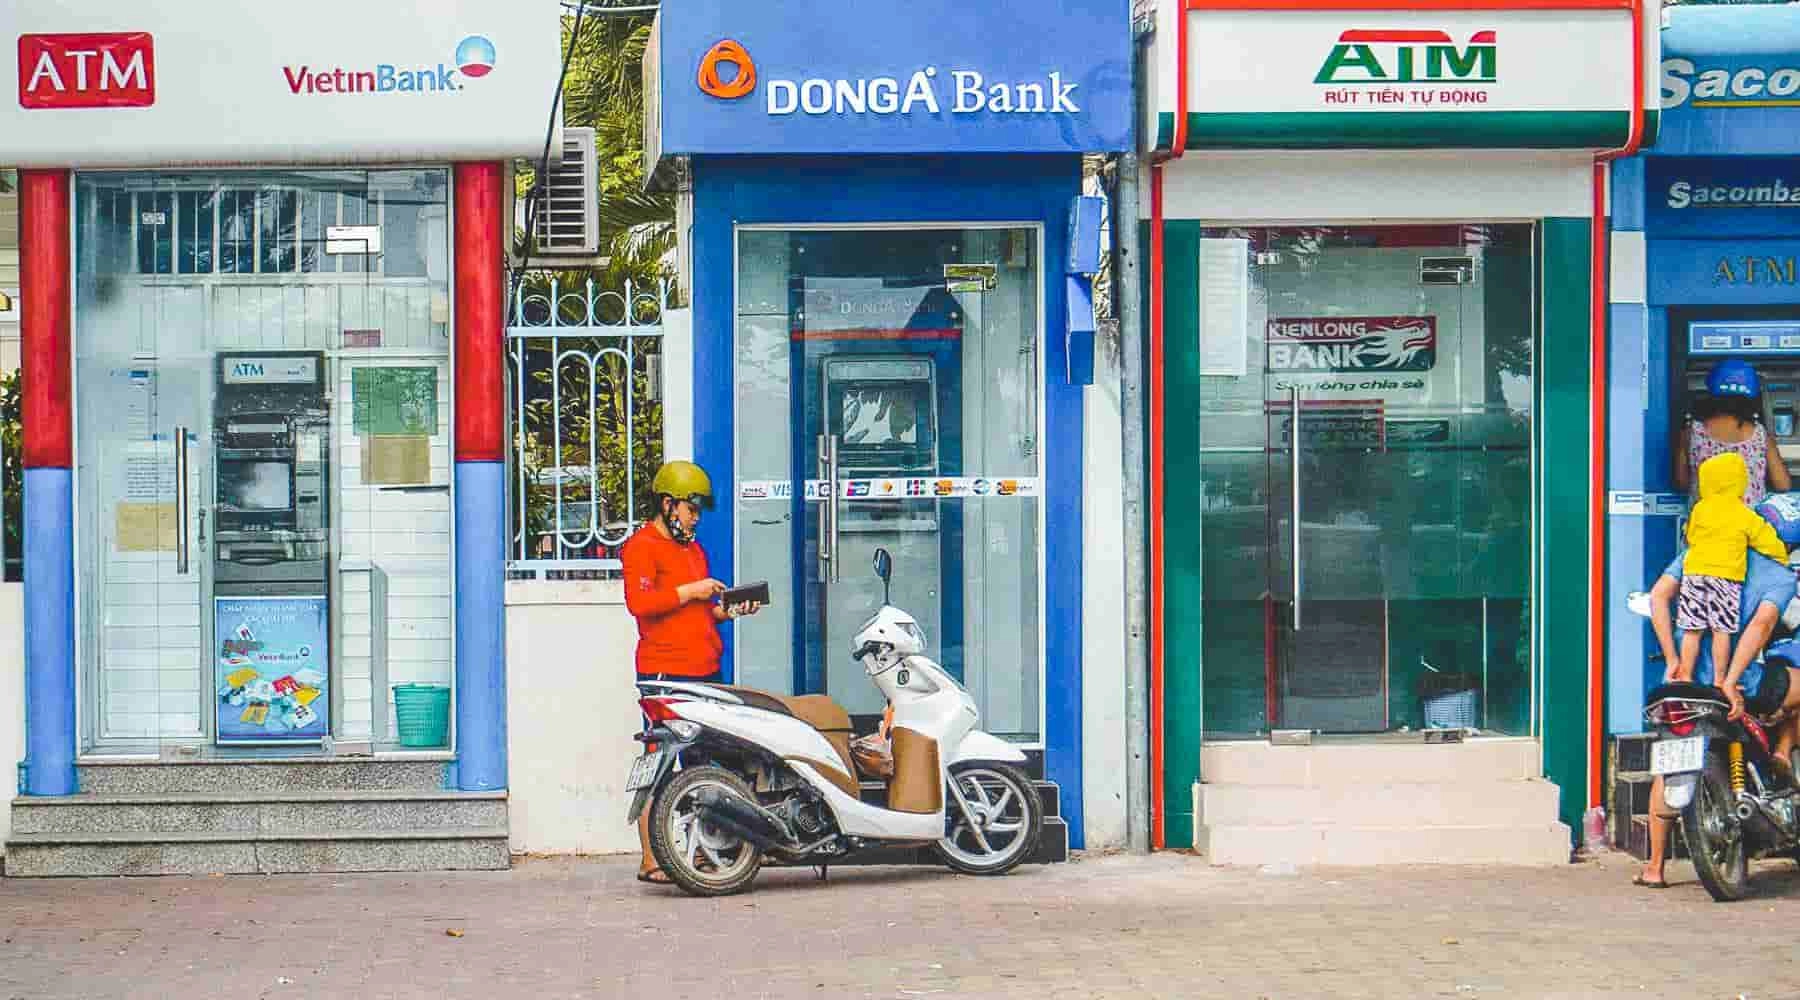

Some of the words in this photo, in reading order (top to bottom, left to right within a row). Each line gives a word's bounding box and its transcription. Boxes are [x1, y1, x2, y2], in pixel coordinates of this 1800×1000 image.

[26, 50, 147, 91] ATM
[1313, 30, 1496, 84] ATM
[951, 70, 1081, 114] Bank
[1325, 88, 1360, 104] RÚT
[1713, 256, 1796, 286] ATM
[1268, 322, 1368, 337] KIENLONG
[231, 363, 265, 377] ATM
[1268, 344, 1365, 369] BANK
